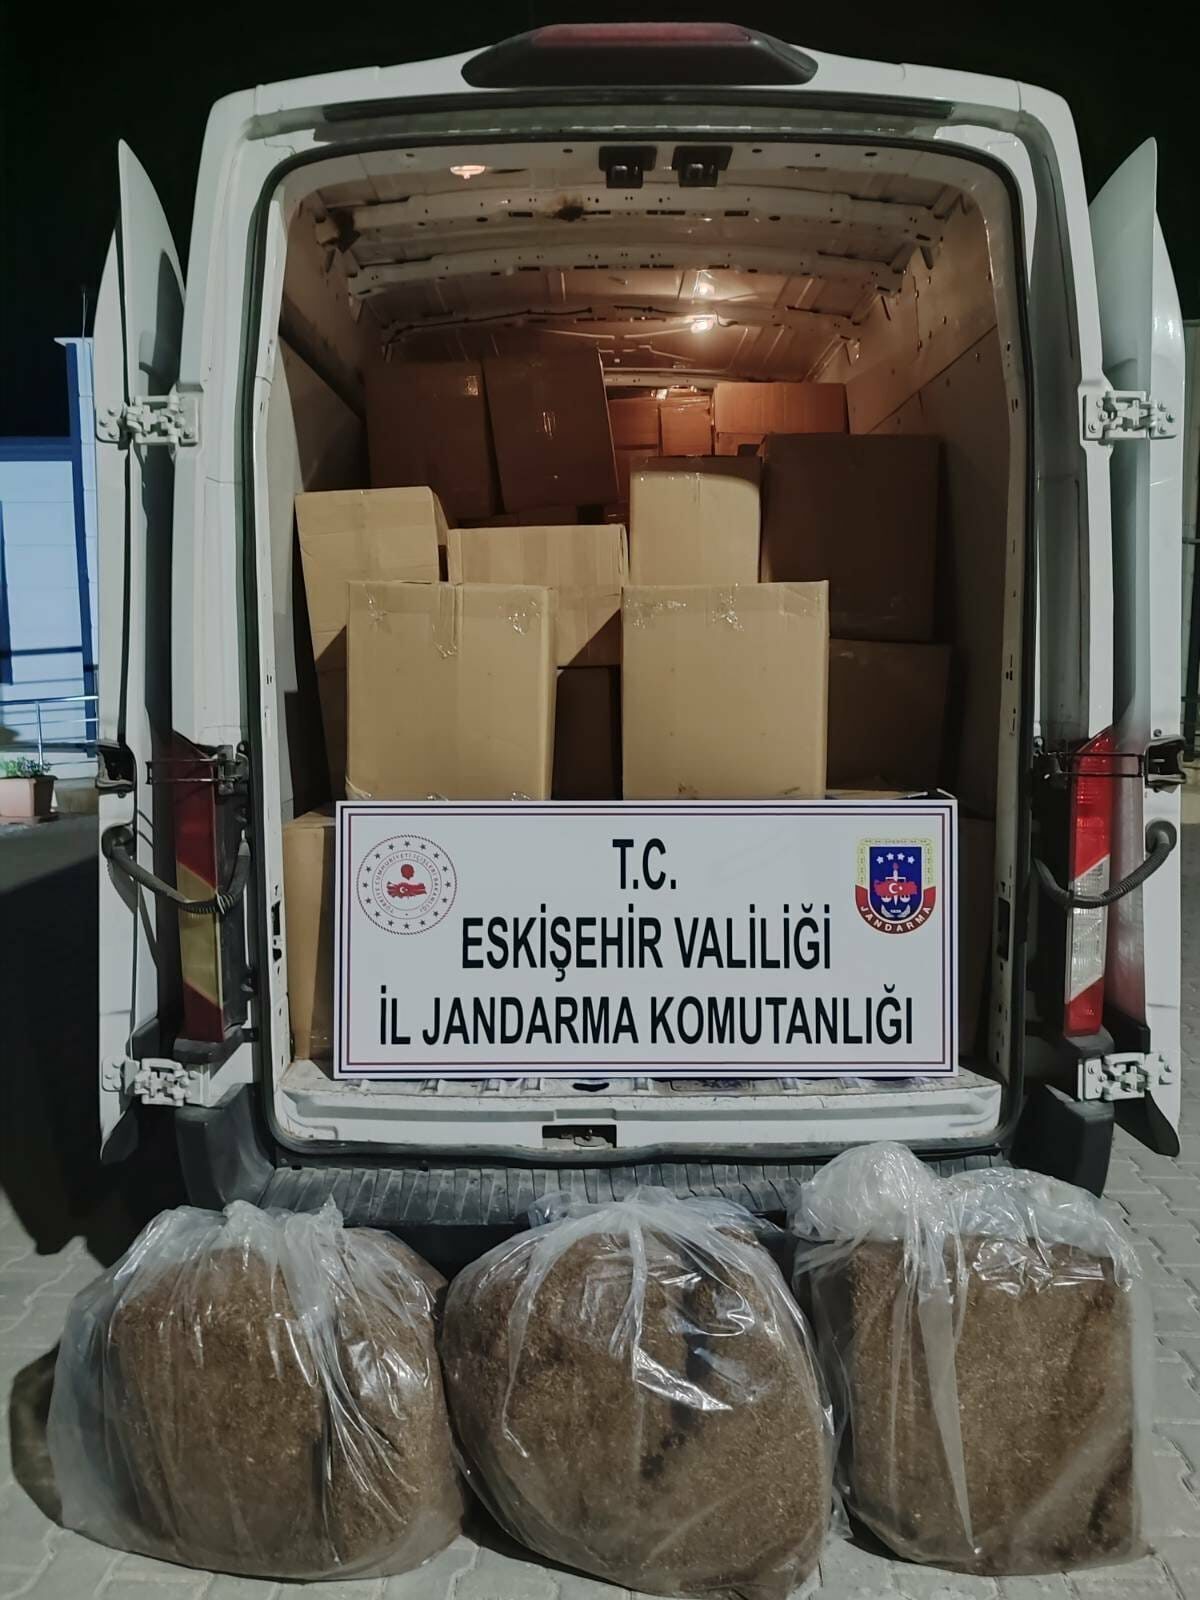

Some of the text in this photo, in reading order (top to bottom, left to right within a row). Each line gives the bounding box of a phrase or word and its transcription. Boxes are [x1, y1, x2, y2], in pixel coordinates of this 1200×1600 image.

[612, 838, 677, 890] T.C.
[462, 903, 831, 983] ESKİŞEHİR VALİLİĞİ
[860, 906, 932, 932] JANDARMA
[380, 983, 913, 1046] İL JANDARMA KOMUTANLIĞI
